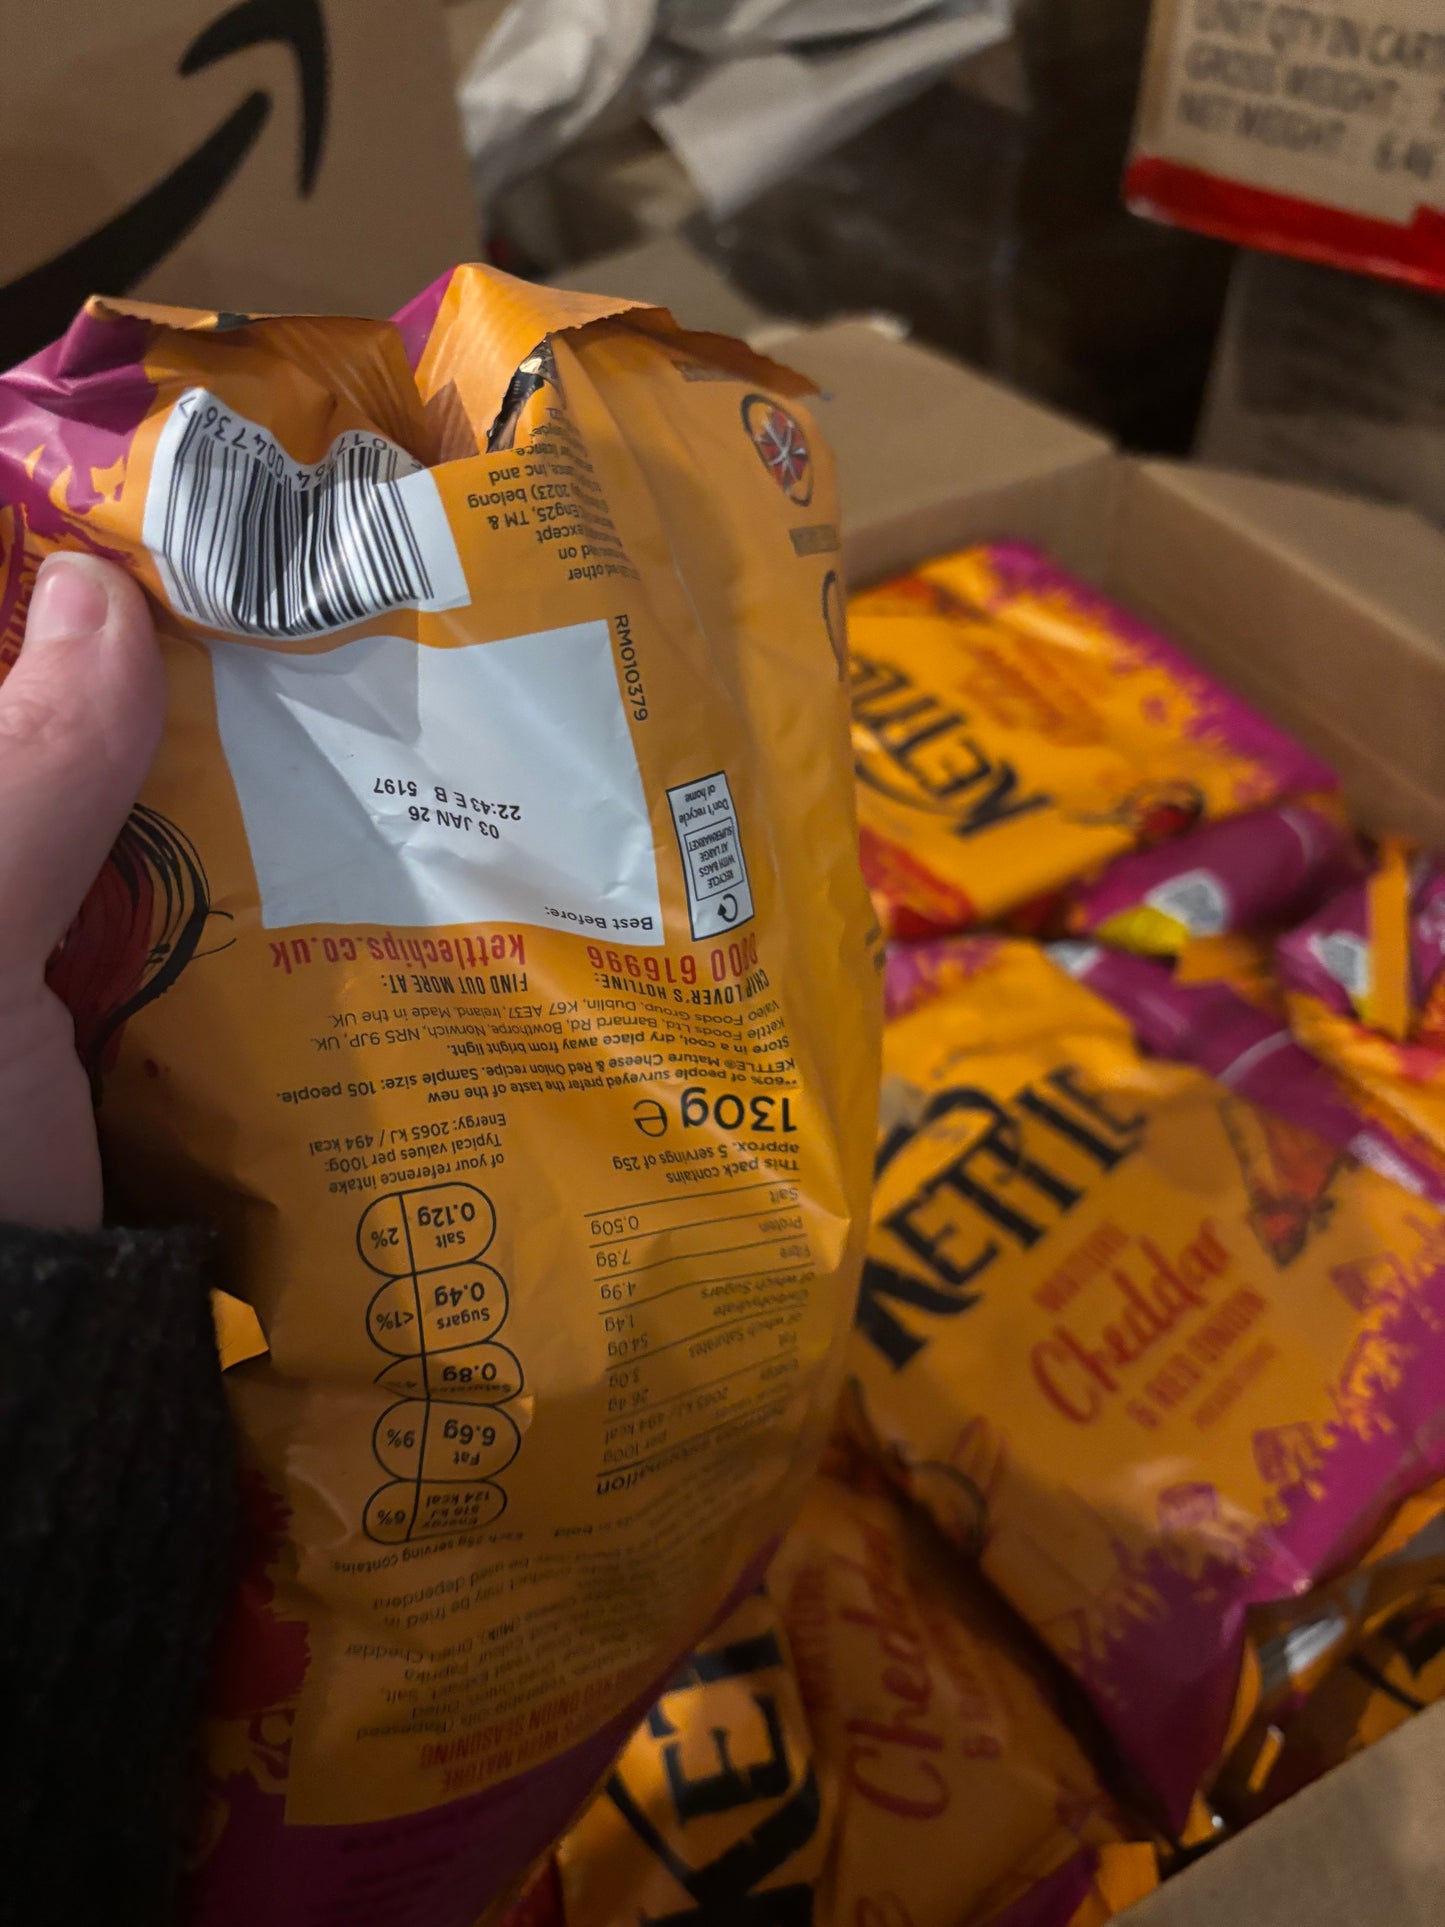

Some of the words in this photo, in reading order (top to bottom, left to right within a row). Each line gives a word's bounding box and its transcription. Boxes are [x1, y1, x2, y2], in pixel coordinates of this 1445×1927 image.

[296, 433, 387, 488] 01764
[488, 467, 520, 485] and
[466, 486, 528, 512] belong
[486, 515, 500, 530] &
[504, 510, 530, 528] TM
[536, 524, 585, 543] except
[558, 547, 577, 560] on
[567, 564, 604, 581] other
[373, 777, 418, 798] 5197
[433, 786, 448, 804] B
[685, 787, 705, 803] home
[453, 791, 466, 809] E
[471, 796, 521, 821] 22:43
[707, 798, 729, 815] Don't
[407, 805, 431, 823] 26
[436, 809, 473, 831] JAN
[679, 806, 705, 827] recycle
[479, 820, 500, 840] 03
[688, 826, 732, 851] SUPERMARKET
[699, 846, 720, 862] LARGE
[720, 842, 728, 853] AT
[698, 862, 718, 877] BAGS
[718, 855, 735, 867] WITH
[707, 870, 734, 889] RECYCLE
[544, 906, 607, 930] Before:
[611, 916, 654, 931] Best
[265, 929, 526, 975] kettlechips.co.uk
[586, 945, 697, 985] 616996
[380, 973, 408, 994] AT:
[413, 974, 456, 993] MORE
[460, 974, 486, 995] OUT
[490, 972, 528, 993] FIND
[594, 973, 667, 999] HOTLINE:
[745, 967, 770, 999] CHIP
[412, 1006, 451, 1021] Made
[502, 1004, 544, 1020] AE37,
[548, 1000, 578, 1015] K67
[583, 999, 637, 1012] Dublin,
[641, 1001, 691, 1020] Group,
[748, 999, 780, 1022] Valeo
[327, 1013, 357, 1028] UK.
[361, 1011, 389, 1026] the
[393, 1009, 407, 1022] in
[596, 1016, 658, 1029] Barnard
[697, 1013, 743, 1026] Foods
[422, 1021, 485, 1038] Norwich,
[486, 1022, 563, 1037] Bowthorpe,
[566, 1019, 591, 1032] Rd,
[662, 1019, 691, 1034] Ltd,
[698, 1027, 743, 1041] Foods
[747, 1017, 784, 1039] Kettle
[309, 1035, 341, 1052] UK.
[343, 1031, 380, 1048] 9JP,
[384, 1027, 420, 1044] NR5
[603, 1031, 645, 1048] place
[650, 1030, 676, 1047] dry
[680, 1035, 715, 1049] cool,
[447, 1042, 484, 1058] light.
[487, 1040, 526, 1056] bright
[528, 1041, 560, 1055] from
[562, 1036, 599, 1053] away
[719, 1044, 729, 1053] a
[734, 1045, 747, 1058] in
[753, 1035, 789, 1054] Store
[569, 1061, 592, 1073] Red
[595, 1059, 605, 1070] &
[608, 1053, 664, 1069] Cheese
[668, 1053, 720, 1067] Mature
[422, 1066, 478, 1085] Sample
[481, 1062, 526, 1077] recipe.
[529, 1062, 566, 1078] Onion
[675, 1067, 727, 1080] people
[731, 1073, 746, 1082] of
[380, 1074, 418, 1091] size:
[545, 1078, 564, 1092] the
[567, 1076, 601, 1090] prefer
[606, 1070, 670, 1087] surveyed
[276, 1081, 342, 1105] people.
[347, 1080, 376, 1097] 105
[464, 1084, 488, 1100] the
[493, 1083, 507, 1096] of
[510, 1081, 543, 1094] taste
[427, 1089, 459, 1104] new
[679, 1086, 798, 1133] 130g
[452, 1112, 506, 1130] Energy:
[390, 1128, 407, 1144] kJ
[411, 1121, 449, 1139] 2065
[309, 1139, 341, 1157] kcal
[346, 1134, 374, 1151] 494
[400, 1141, 447, 1161] values
[451, 1132, 502, 1155] Typical
[732, 1140, 799, 1154] approx.
[372, 1149, 396, 1167] per
[490, 1152, 504, 1168] of
[660, 1146, 714, 1166] servings
[717, 1144, 728, 1159] 5
[324, 1155, 369, 1174] 100g:
[455, 1152, 487, 1170] your
[612, 1156, 640, 1172] 25g
[643, 1155, 656, 1169] of
[724, 1157, 759, 1178] pack
[764, 1158, 799, 1171] This
[380, 1162, 451, 1184] reference
[666, 1166, 719, 1185] contains
[329, 1175, 377, 1194] intake
[768, 1186, 799, 1205] Salt
[417, 1201, 476, 1228] 0.12g
[590, 1215, 640, 1237] 0.50g
[370, 1226, 400, 1250] 2%
[436, 1230, 466, 1249] Salt
[595, 1247, 631, 1269] 7.8g
[434, 1281, 485, 1307] 0.4g
[600, 1281, 637, 1301] 4.9g
[701, 1281, 752, 1299] Sugars
[375, 1311, 415, 1332] <1%
[436, 1307, 491, 1331] Sugars
[604, 1313, 635, 1334] 1.4g
[1030, 1216, 1234, 1426] Cheddar
[607, 1332, 649, 1357] 54.0g
[689, 1331, 744, 1359] Saturates
[443, 1362, 497, 1383] 0.8g
[386, 1428, 415, 1449] 9%
[443, 1419, 496, 1447] 6.6g
[453, 1450, 481, 1466] Fat
[425, 1494, 460, 1508] kcal
[464, 1490, 490, 1501] 124
[377, 1509, 407, 1526] 6%
[402, 1540, 454, 1561] serving
[451, 1597, 470, 1613] be
[384, 1617, 400, 1628] in
[406, 1608, 446, 1628] fried
[345, 1643, 424, 1663] Cheddar
[419, 1714, 525, 1769] SEASONING
